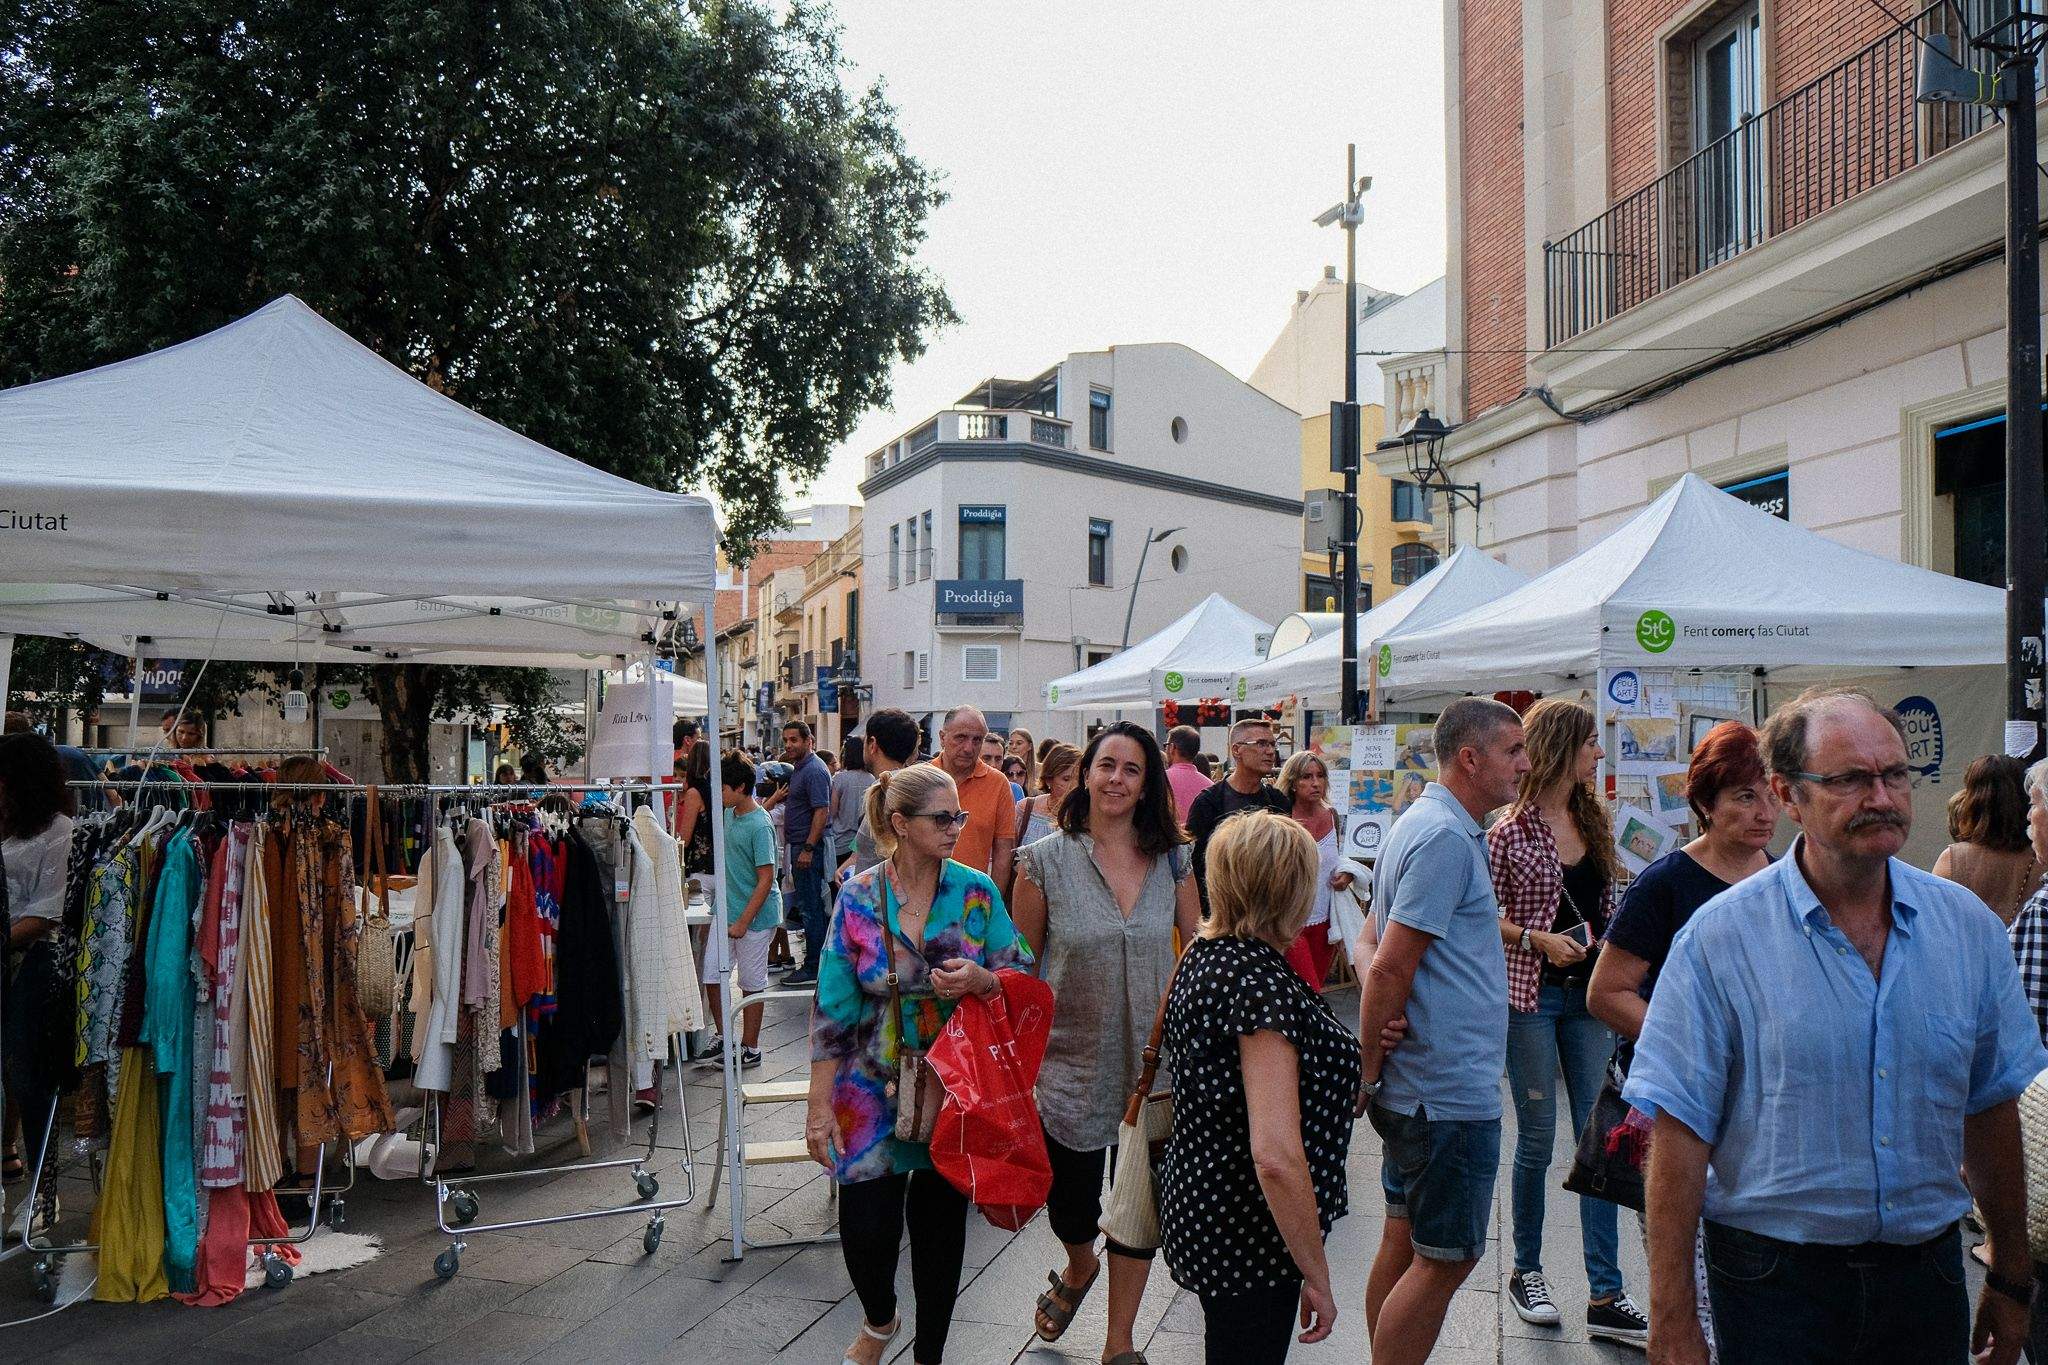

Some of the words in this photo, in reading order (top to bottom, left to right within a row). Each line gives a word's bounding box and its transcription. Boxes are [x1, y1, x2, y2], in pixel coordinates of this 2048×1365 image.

[0, 509, 69, 531] Ciutat
[963, 509, 1002, 519] Proddigia
[944, 589, 1013, 608] Proddigia
[1641, 617, 1670, 638] StC
[1684, 625, 1709, 637] Fent
[1711, 626, 1755, 639] comerç
[1757, 625, 1774, 637] fas
[1776, 624, 1810, 637] Ciutat
[1201, 677, 1223, 685] comerç
[612, 713, 628, 724] Rita
[1354, 727, 1395, 736] Tallers
